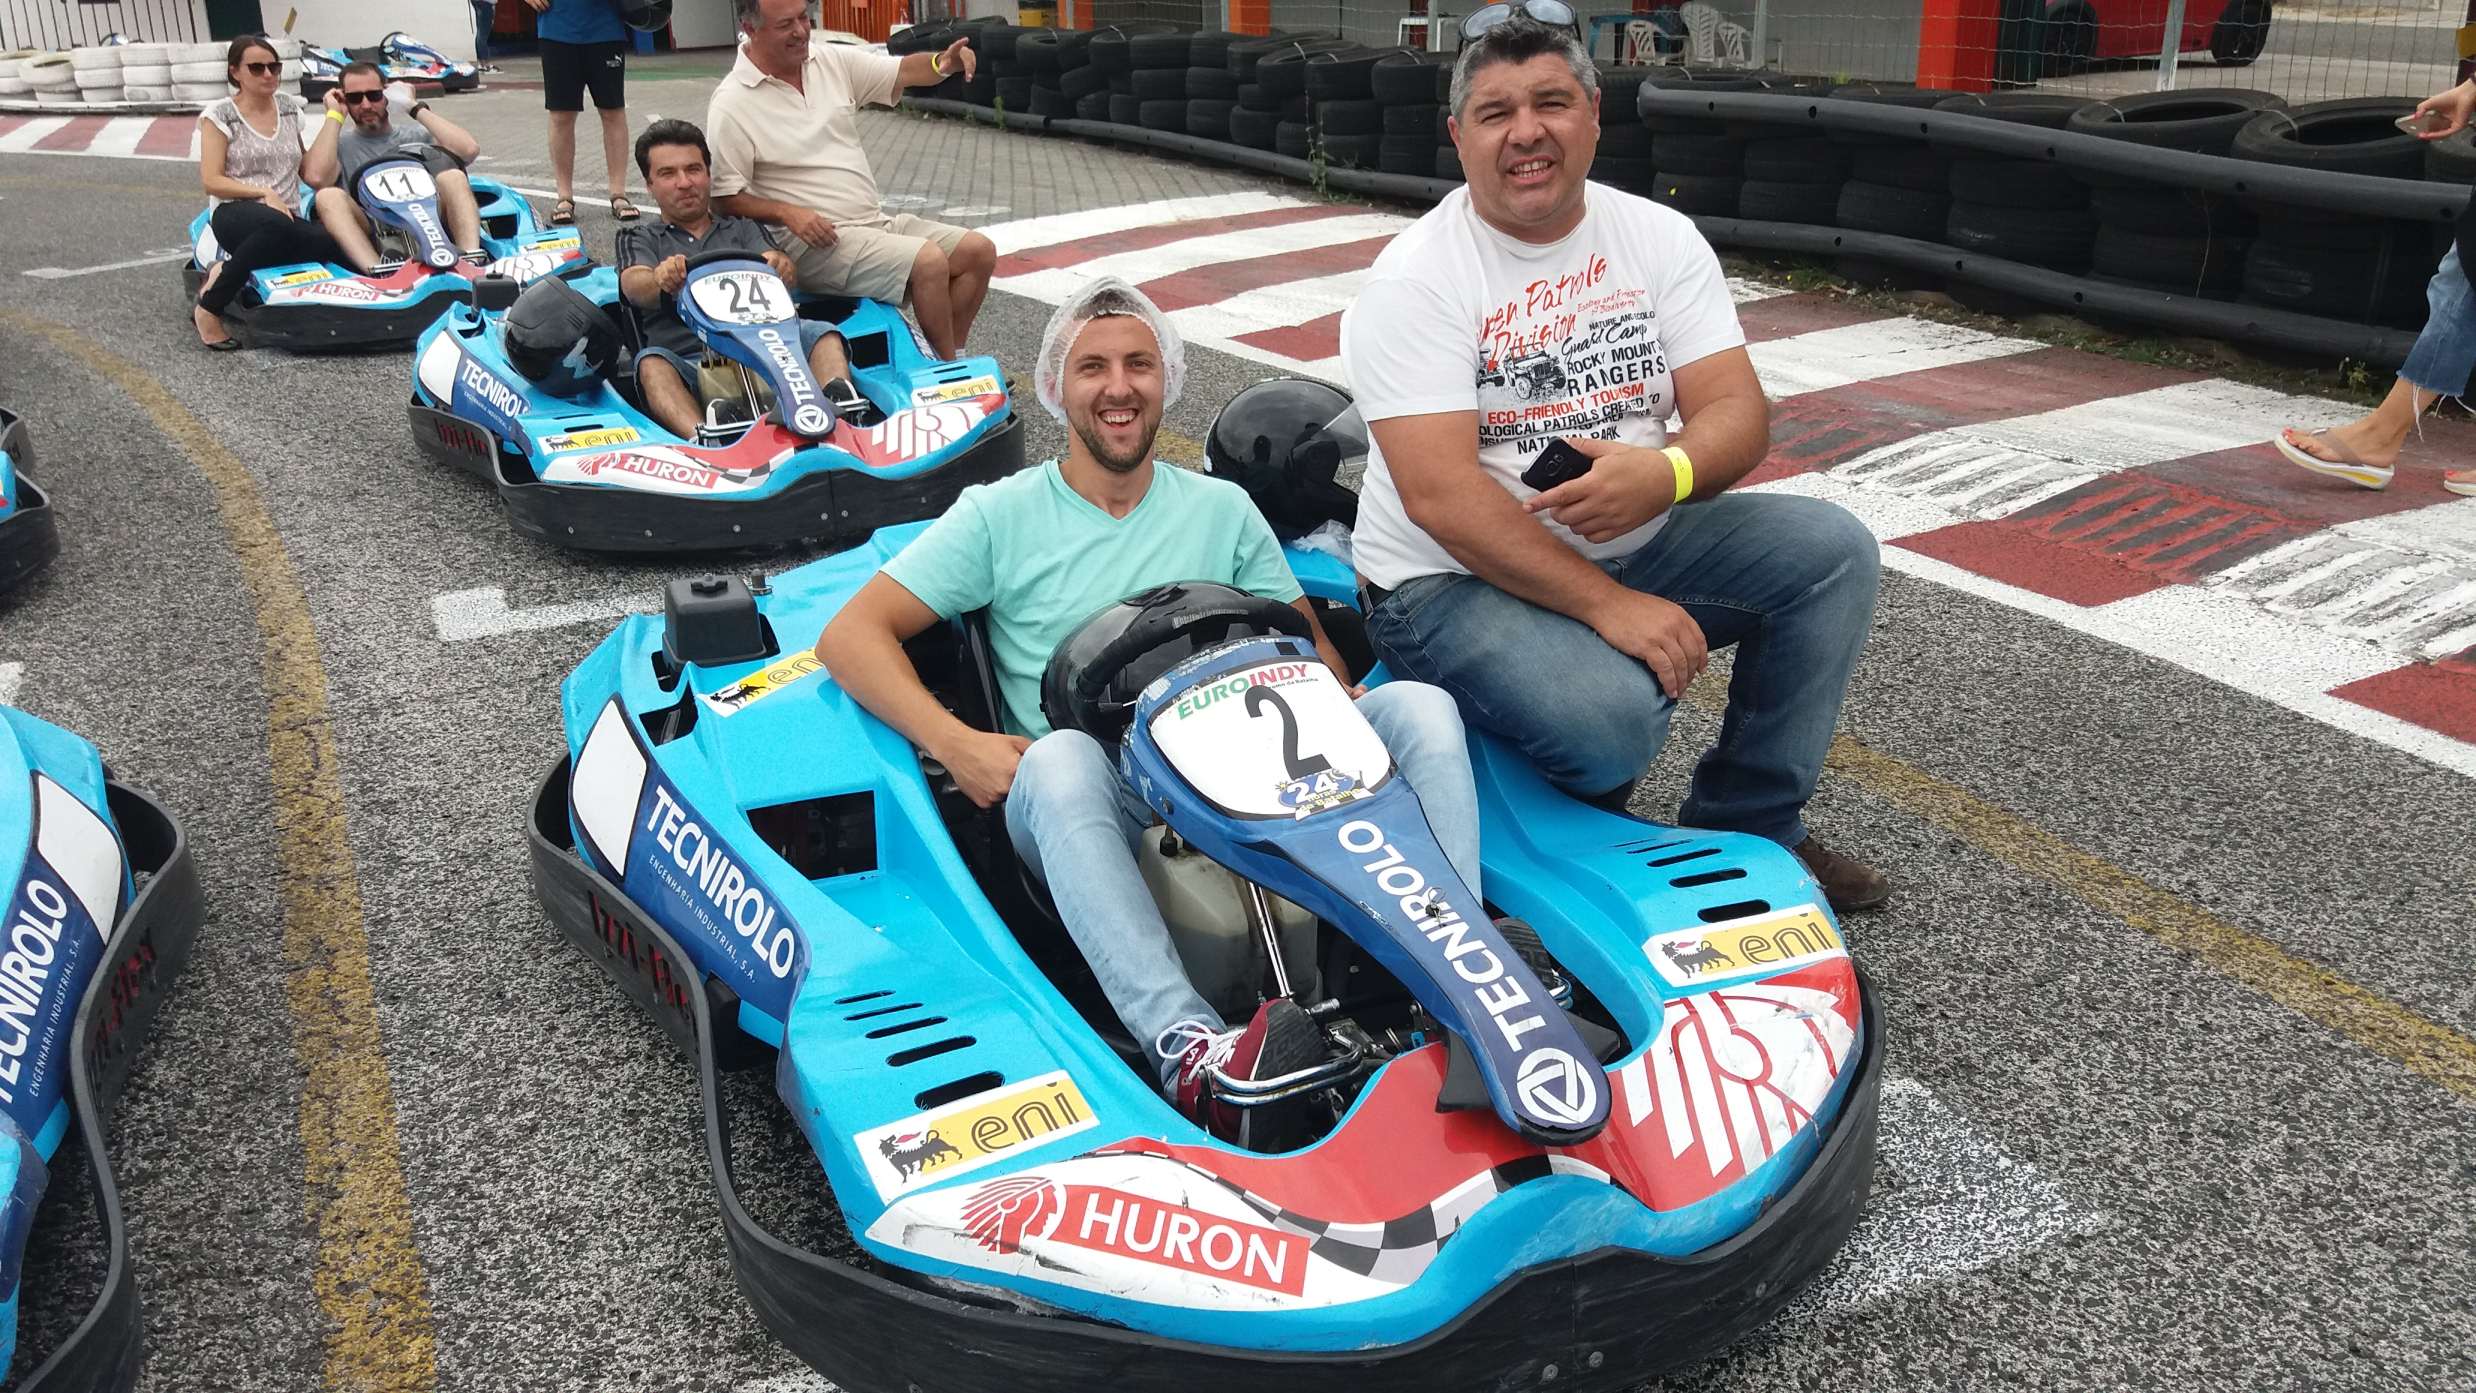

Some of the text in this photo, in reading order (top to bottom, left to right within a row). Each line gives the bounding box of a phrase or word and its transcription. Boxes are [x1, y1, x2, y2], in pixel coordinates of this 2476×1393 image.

[378, 173, 416, 197] 11
[318, 282, 376, 301] HURON
[719, 276, 772, 313] 24
[1525, 253, 1607, 317] Patrols
[1487, 313, 1577, 373] Division
[1589, 316, 1617, 331] NATURE
[1605, 322, 1648, 344] Camp
[1567, 335, 1663, 376] ROCKY MOUNT
[1567, 355, 1666, 397] RANGERS
[1487, 397, 1586, 426] ECO-FRIENDLY
[1543, 409, 1600, 432] PATROLS
[1602, 397, 1644, 418] CREAD
[1649, 393, 1661, 405] O
[584, 427, 640, 447] eni
[623, 456, 710, 487] HURON
[768, 648, 825, 685] en
[1177, 664, 1309, 721] EUROINDY
[1244, 684, 1332, 781] 2
[1286, 772, 1340, 804] 24
[647, 784, 796, 979] TECNIROLO
[649, 854, 757, 984] ENGENHARIA INDUSTRIAL, S.A.
[1337, 819, 1547, 1052] TECNIROLO
[1738, 912, 1834, 966] eni
[0, 879, 68, 1105] ECNIROLO
[30, 937, 82, 1097] ENGENHARIA INDUSTRIAL, S.A.
[970, 1080, 1080, 1155] eni
[1078, 1191, 1289, 1285] HURON
